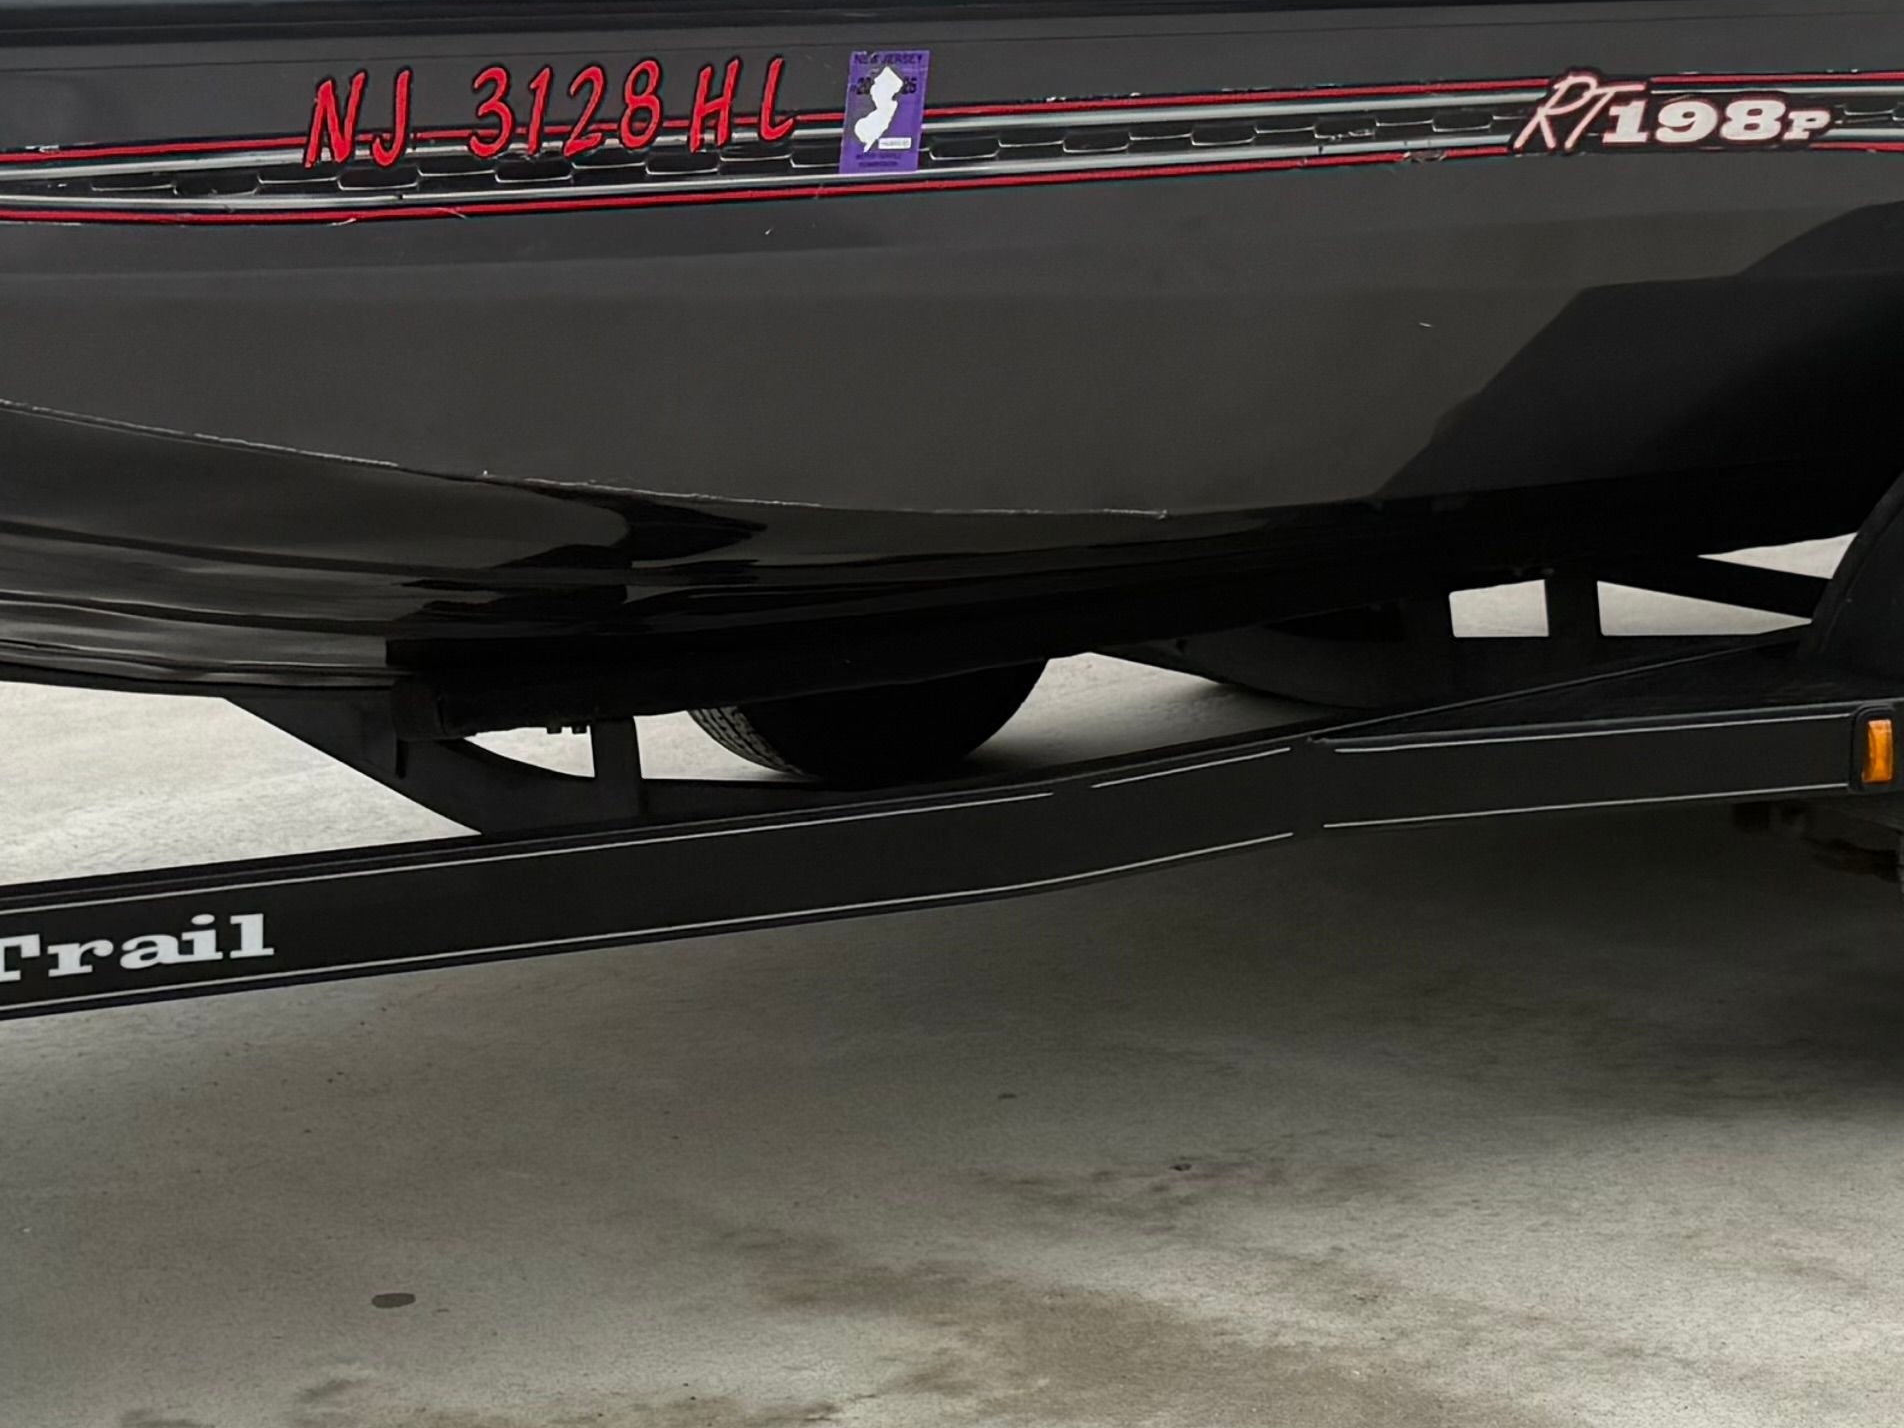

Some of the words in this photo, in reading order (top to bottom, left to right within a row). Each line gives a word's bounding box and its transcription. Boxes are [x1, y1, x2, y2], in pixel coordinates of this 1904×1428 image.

[304, 70, 411, 168] NJ
[469, 59, 662, 157] 3128
[689, 57, 795, 153] HL
